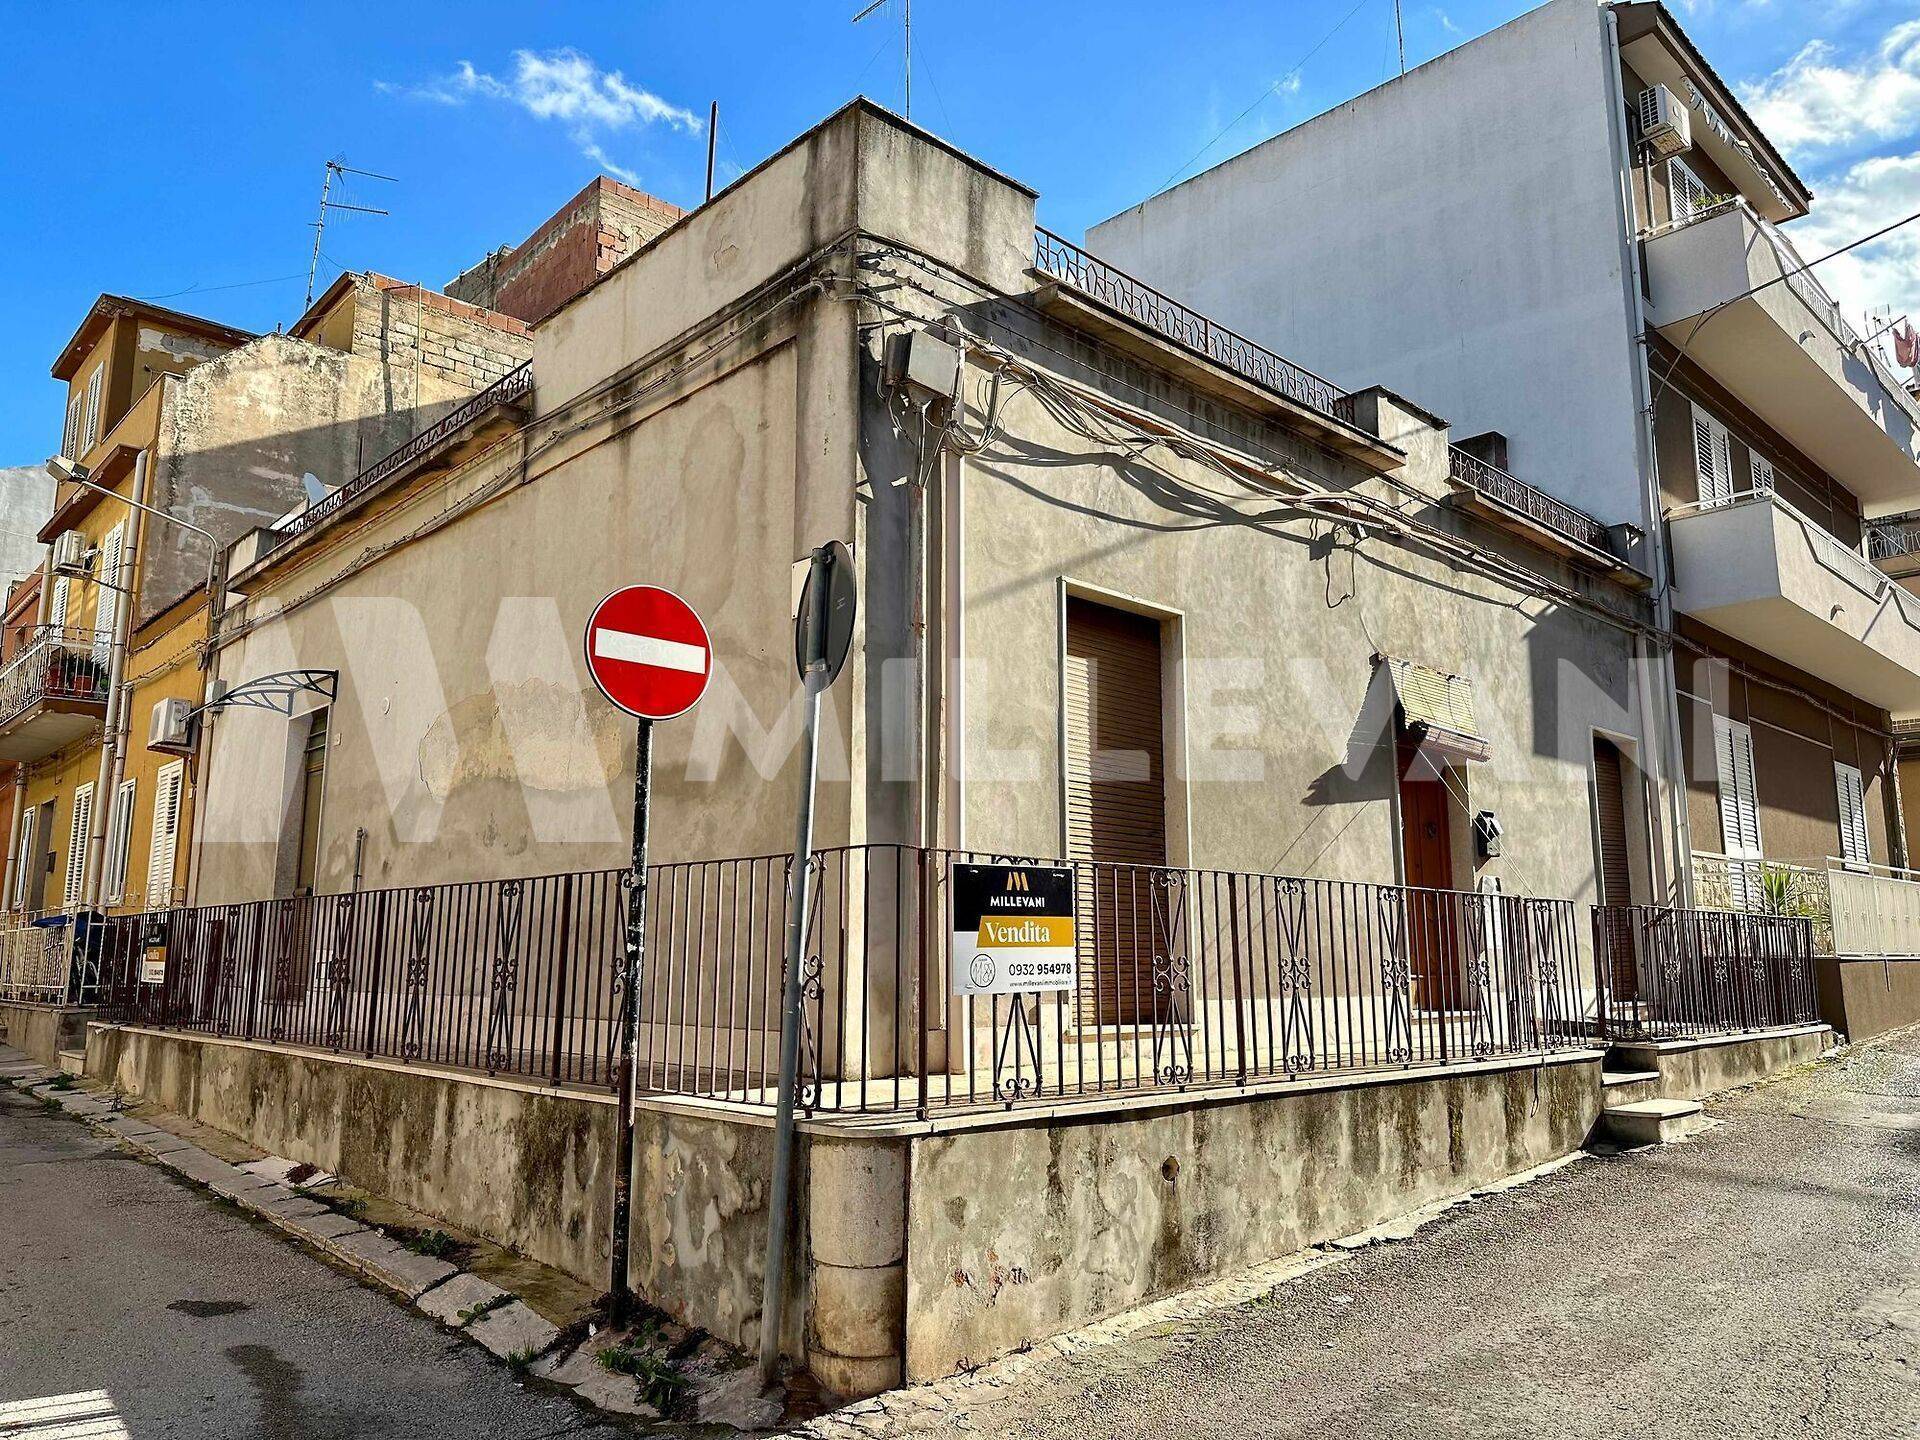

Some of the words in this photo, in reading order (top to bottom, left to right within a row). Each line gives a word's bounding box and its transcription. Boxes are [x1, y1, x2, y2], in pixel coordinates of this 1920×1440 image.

[990, 896, 1045, 908] MILLEVANI
[985, 921, 1051, 943] Vendita
[1009, 964, 1035, 976] 0932
[1037, 963, 1072, 975] 954978
